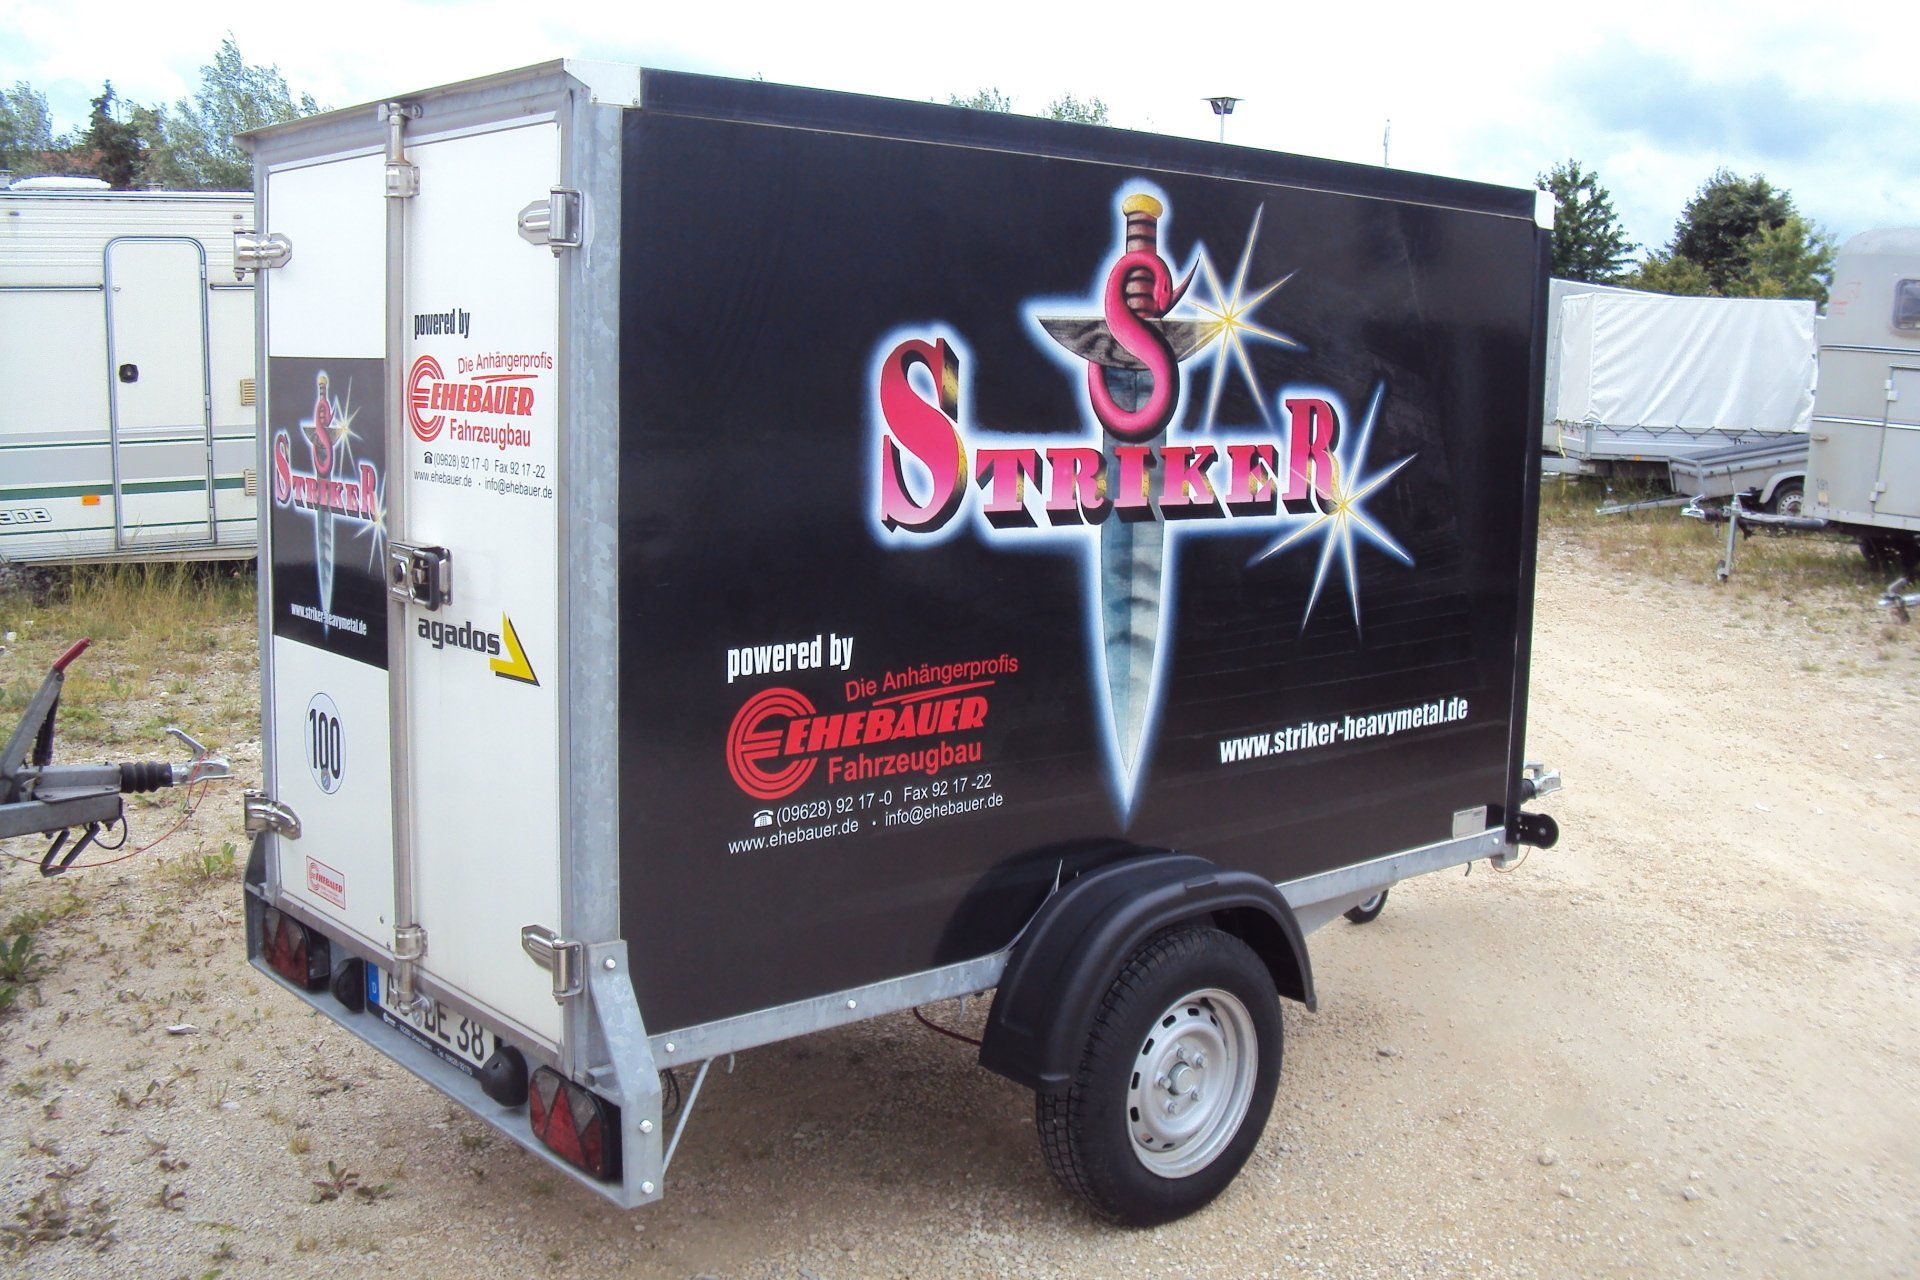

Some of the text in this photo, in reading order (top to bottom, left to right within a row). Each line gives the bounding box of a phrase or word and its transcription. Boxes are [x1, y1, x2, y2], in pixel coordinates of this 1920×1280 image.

[414, 308, 470, 340] powered by
[457, 351, 553, 374] Die Anhängerprofis
[430, 382, 535, 416] EHEBAUER
[449, 418, 531, 450] Fahrzeugbau
[880, 338, 1343, 533] STRIKER
[274, 433, 378, 522] STRIKER
[413, 470, 553, 499] www.ehebauer.de info@ehebauer.de
[433, 453, 459, 470] (09628)
[460, 455, 470, 469] 92
[472, 458, 480, 470] 17
[494, 459, 509, 474] Fax
[510, 461, 520, 475] 92
[522, 463, 531, 476] 17
[290, 602, 368, 637] www.striker-heavymetal.de
[418, 617, 501, 656] agados
[727, 633, 854, 684] powered by
[845, 653, 1019, 702] Die Anhängerprofis
[309, 708, 341, 779] 100
[784, 695, 989, 756] EHEBAUER
[1219, 696, 1468, 764] www.striker-heavymetal.de
[827, 740, 982, 785] Fahrzeugbau
[776, 801, 832, 827] (09628)
[836, 796, 854, 815] 92
[859, 793, 875, 810] 17
[903, 785, 928, 802] Fax
[931, 780, 948, 797] 92
[953, 777, 969, 793] 17
[971, 773, 992, 789] -22
[728, 792, 1003, 854] www.ehebauer.de info@ehebauer.de
[457, 1016, 484, 1061] 38
